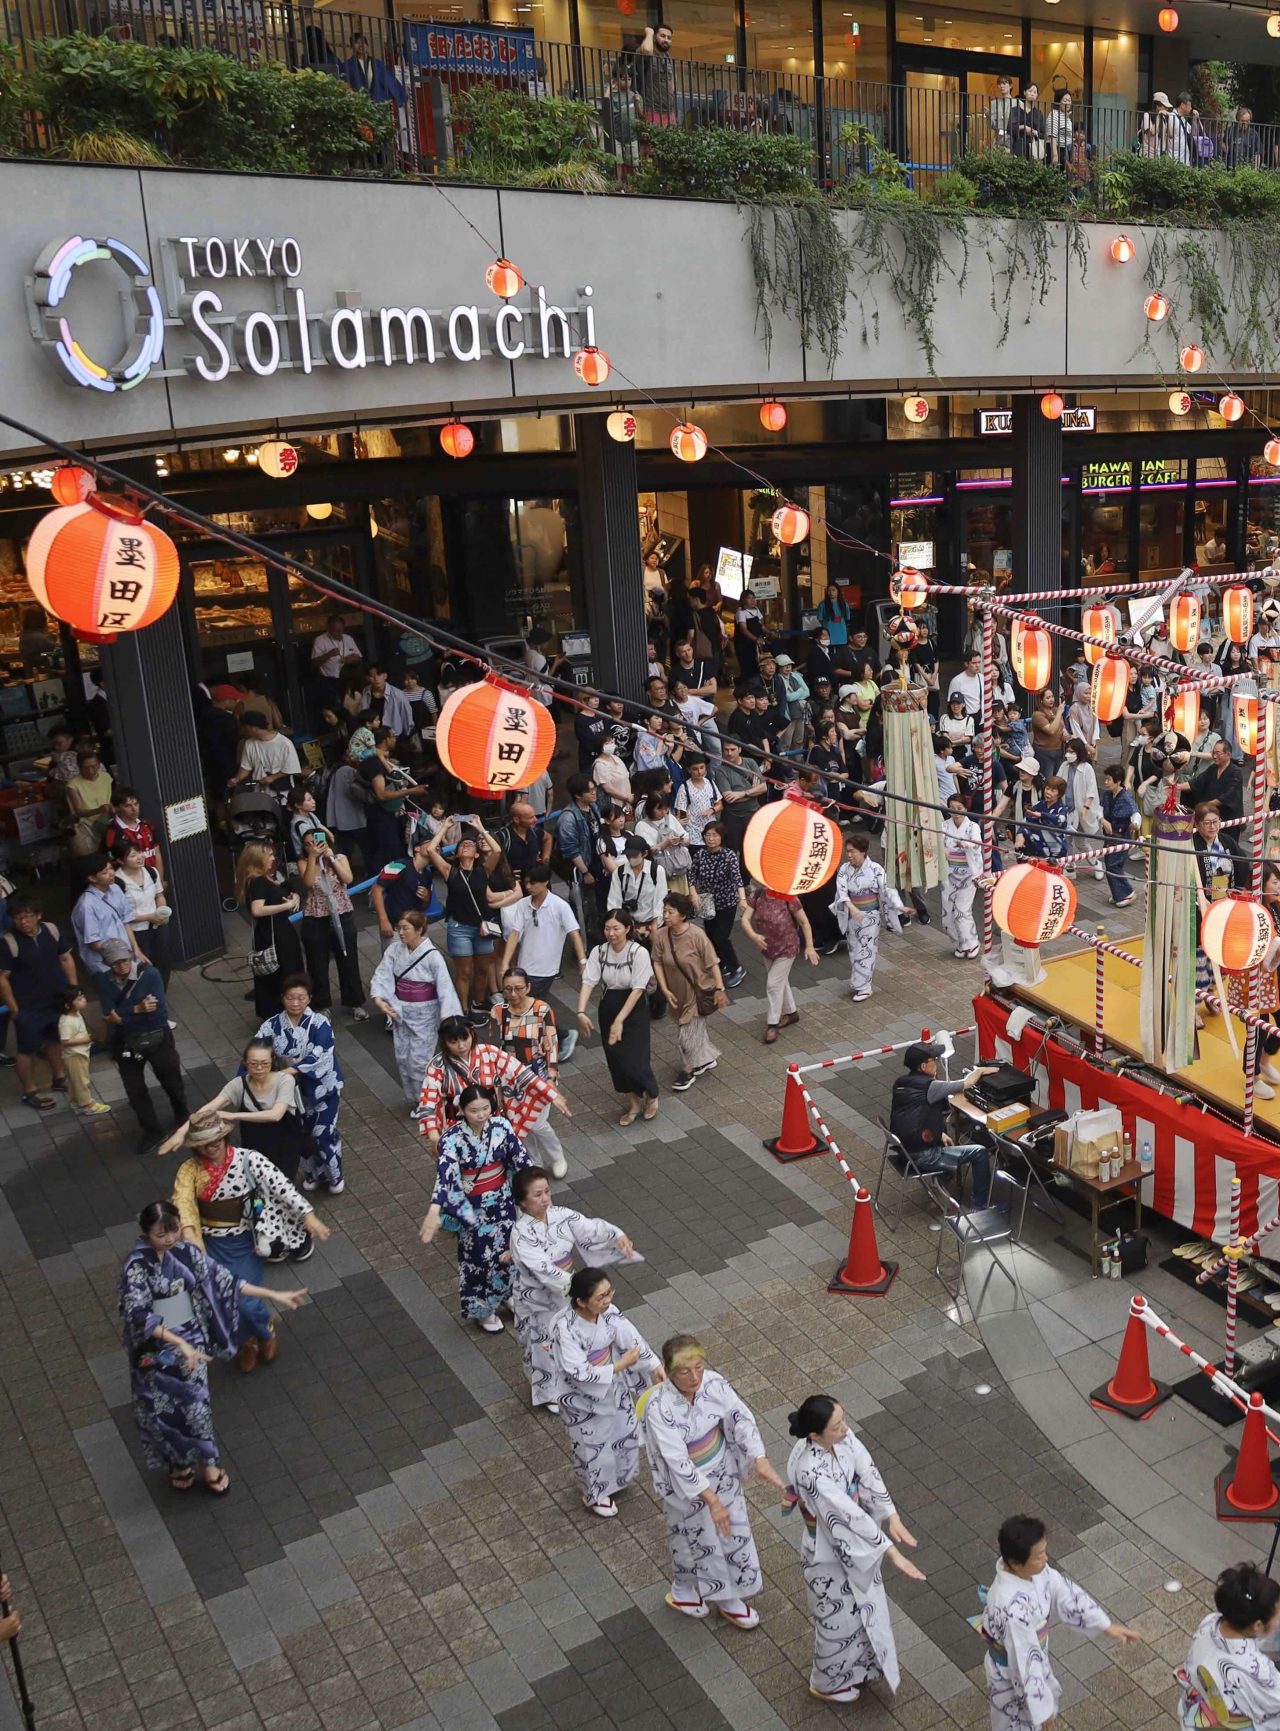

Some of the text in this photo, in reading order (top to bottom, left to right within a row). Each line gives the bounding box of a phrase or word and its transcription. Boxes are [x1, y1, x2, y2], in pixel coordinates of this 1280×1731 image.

[180, 237, 302, 278] TOKYO
[192, 285, 595, 382] Solamachi
[915, 400, 928, 418] 祭
[1180, 396, 1191, 412] 祭
[624, 417, 636, 438] 祭
[279, 448, 298, 473] 祭
[1081, 474, 1131, 488] BURGER
[1089, 459, 1165, 474] HAWAIAN
[97, 537, 147, 630] 墨田区
[488, 706, 528, 787] 墨田区
[792, 822, 829, 891] 民踊連盟
[1039, 884, 1067, 940] 民踊連盟
[1249, 912, 1270, 967] 民踊連盟
